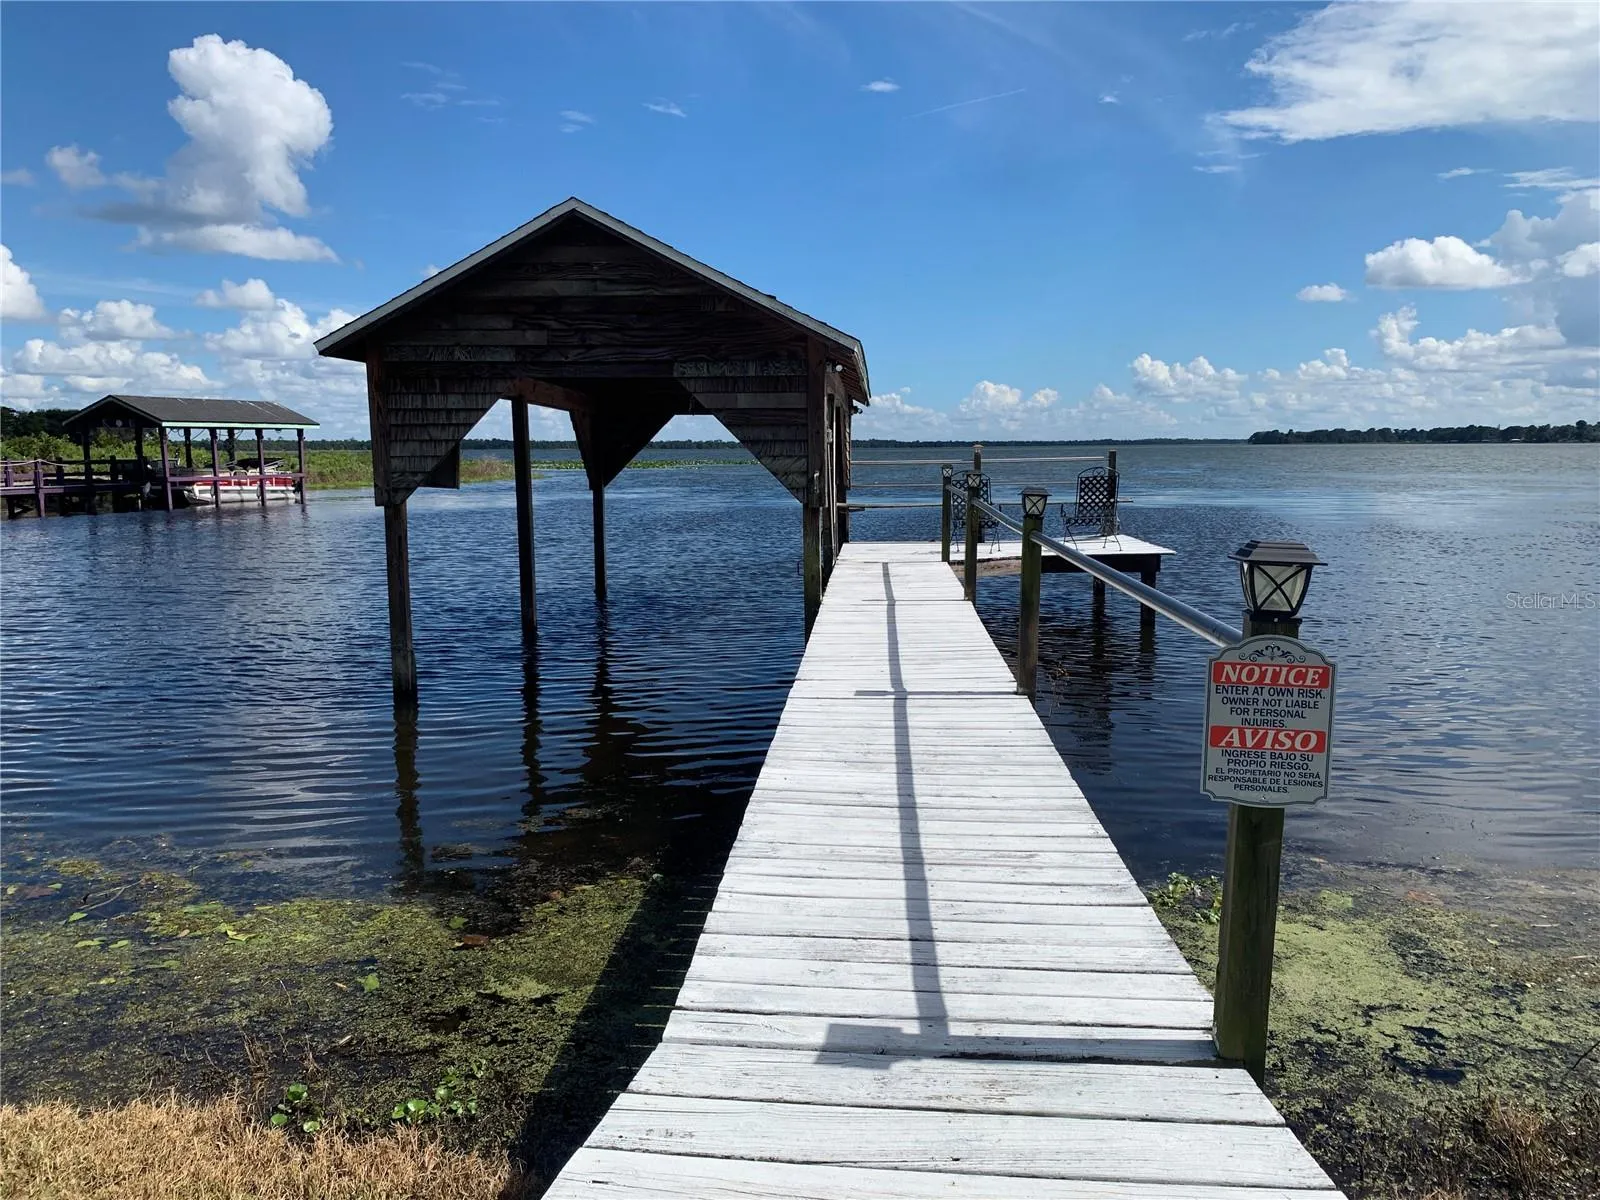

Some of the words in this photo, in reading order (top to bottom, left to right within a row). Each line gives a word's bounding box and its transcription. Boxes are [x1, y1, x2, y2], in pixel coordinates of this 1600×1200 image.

[1220, 664, 1323, 686] NOTICE
[1216, 685, 1248, 695] ENTER
[1252, 687, 1265, 696] AT
[1268, 688, 1293, 697] OWN
[1298, 689, 1325, 699] RISK.
[1222, 697, 1258, 706] OWNER
[1262, 699, 1282, 707] NOT
[1285, 700, 1319, 709] LIABLE
[1230, 707, 1249, 716] FOR
[1253, 708, 1306, 719] PERSONAL
[1241, 718, 1287, 728] INJURIES.
[1218, 728, 1317, 751] AVISO
[1221, 749, 1266, 759] INGRESE
[1270, 752, 1296, 760] BAJO
[1300, 753, 1313, 762] SU
[1227, 759, 1266, 768] PROPIO
[1270, 761, 1311, 771] RIESGO.
[1228, 768, 1281, 777] PROPIETARIO
[1208, 775, 1267, 784] RESPONSABLE
[1283, 779, 1323, 787] LESIONES
[1234, 784, 1289, 793] PERSONALES.
